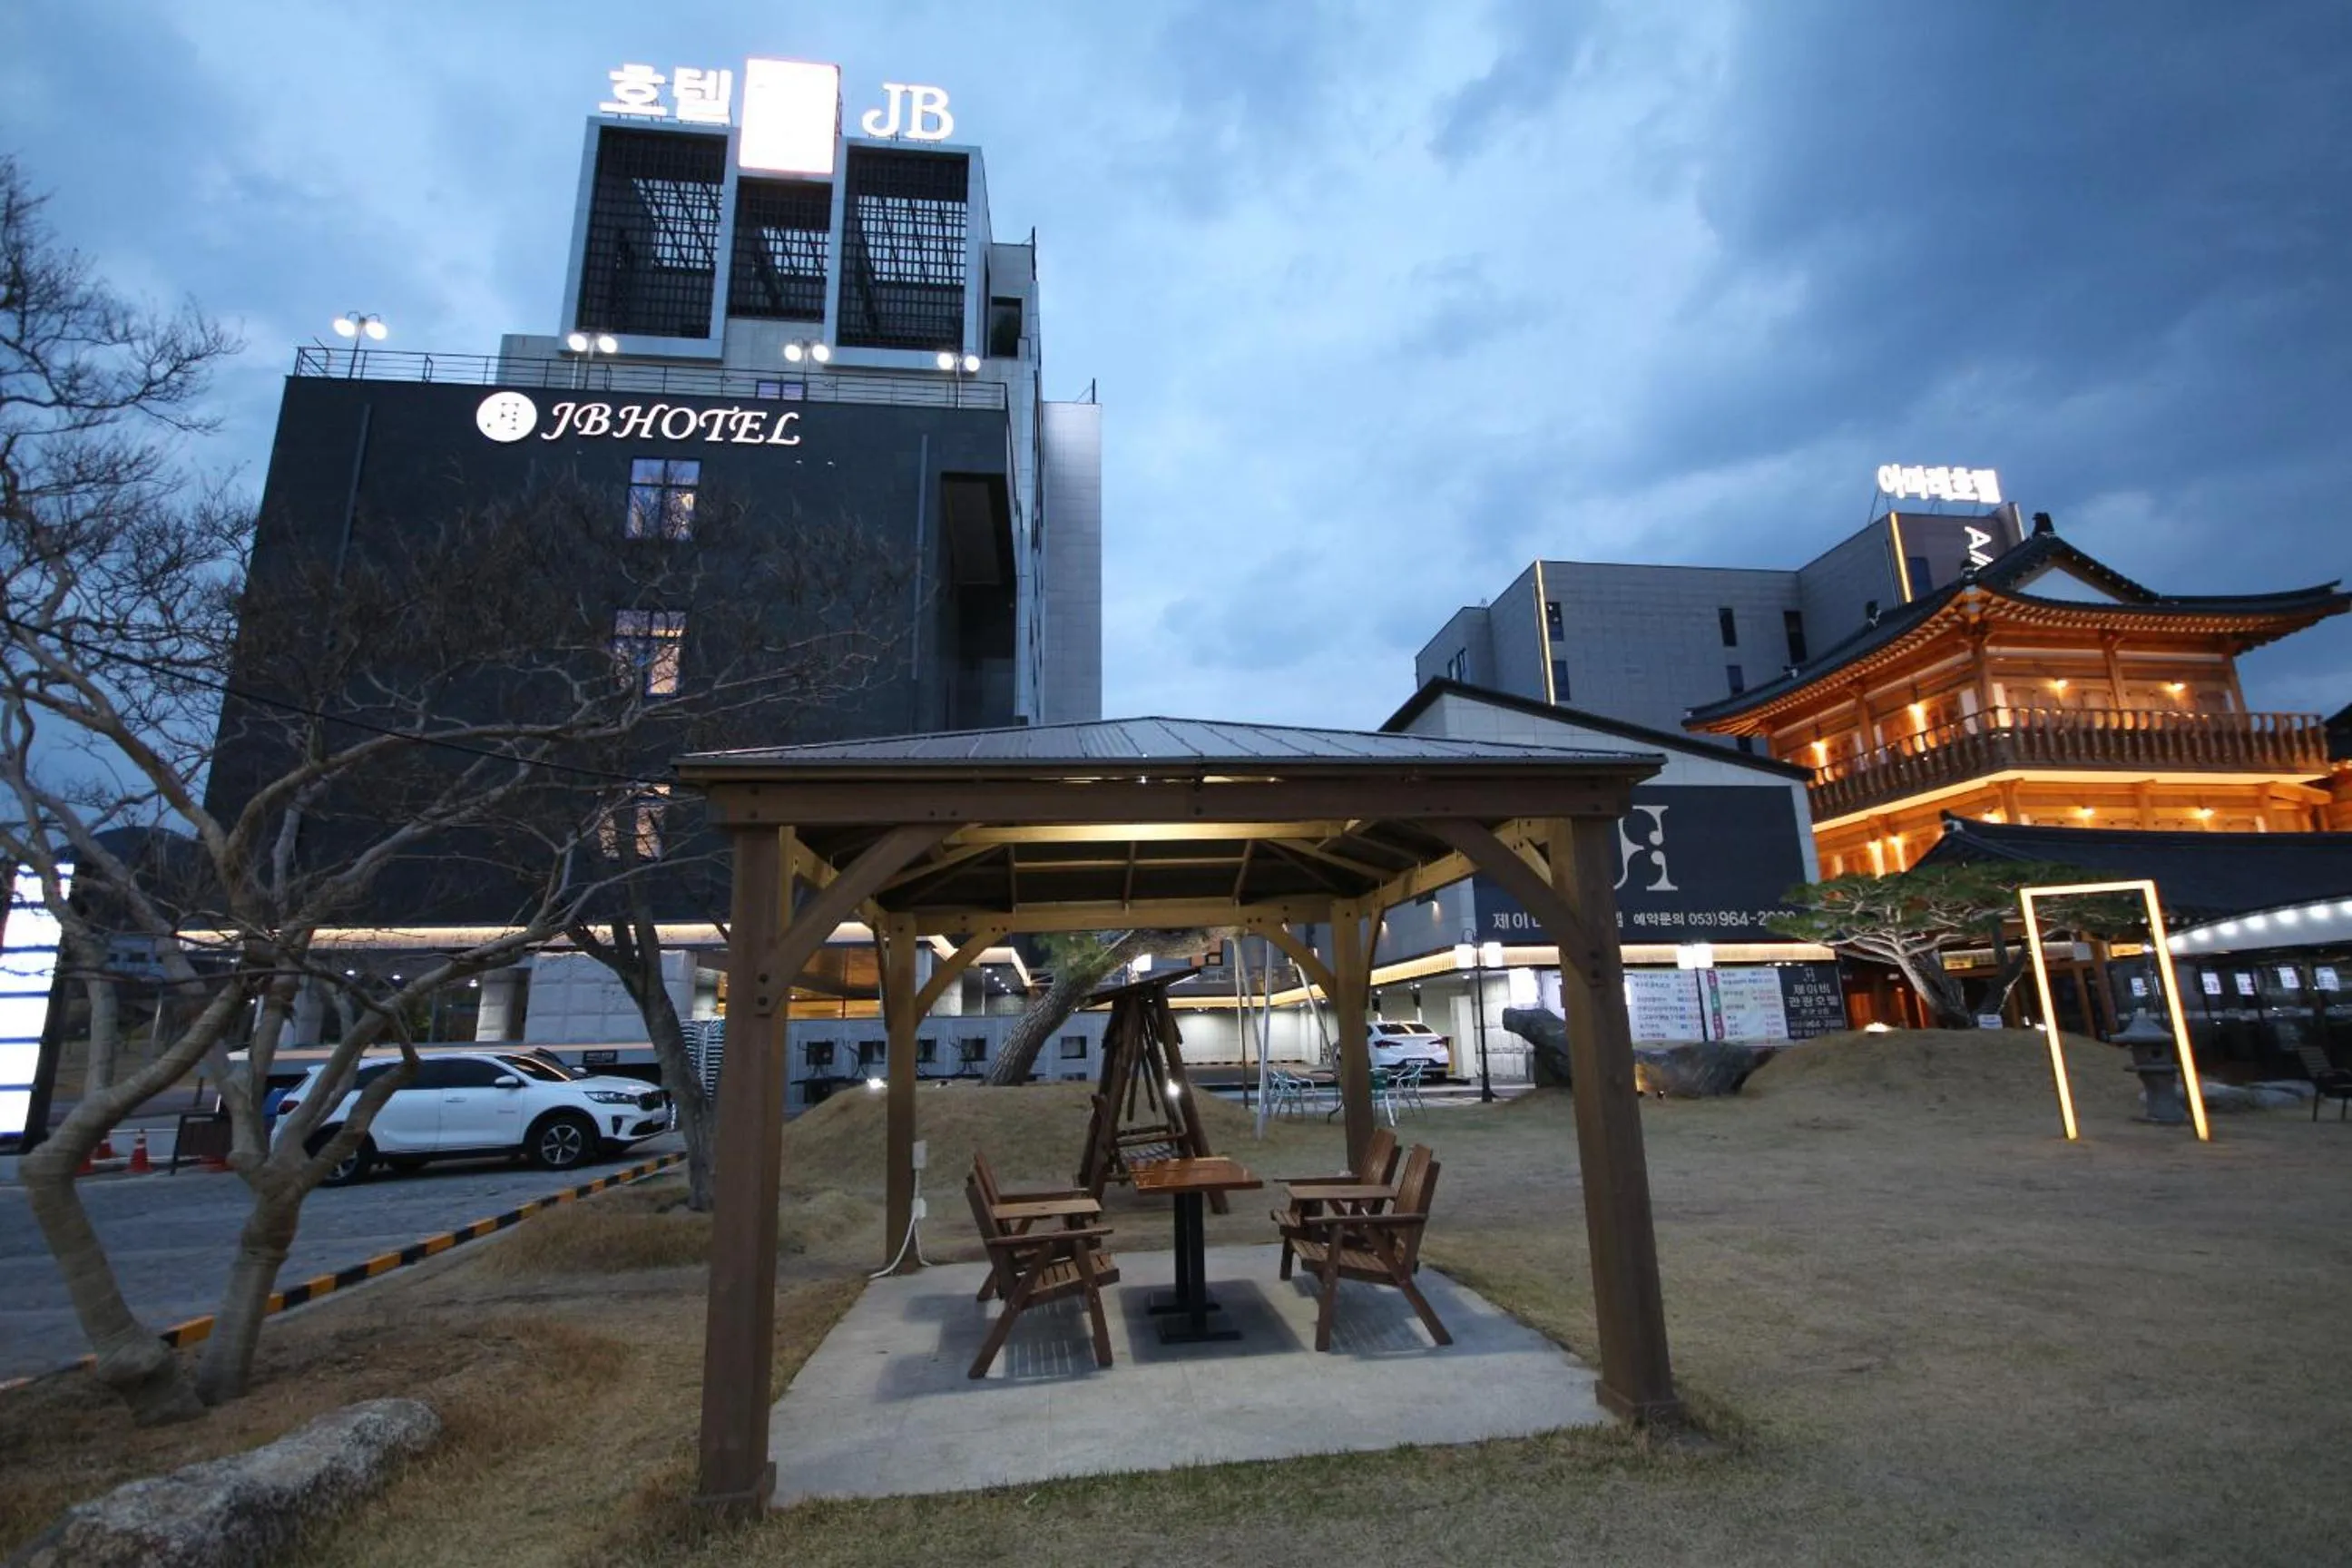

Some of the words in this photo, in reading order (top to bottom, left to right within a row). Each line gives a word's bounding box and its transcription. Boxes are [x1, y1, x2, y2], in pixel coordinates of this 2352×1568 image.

[599, 64, 732, 124] 호텔
[861, 83, 954, 140] JB
[1633, 911, 1685, 926] 예약문의
